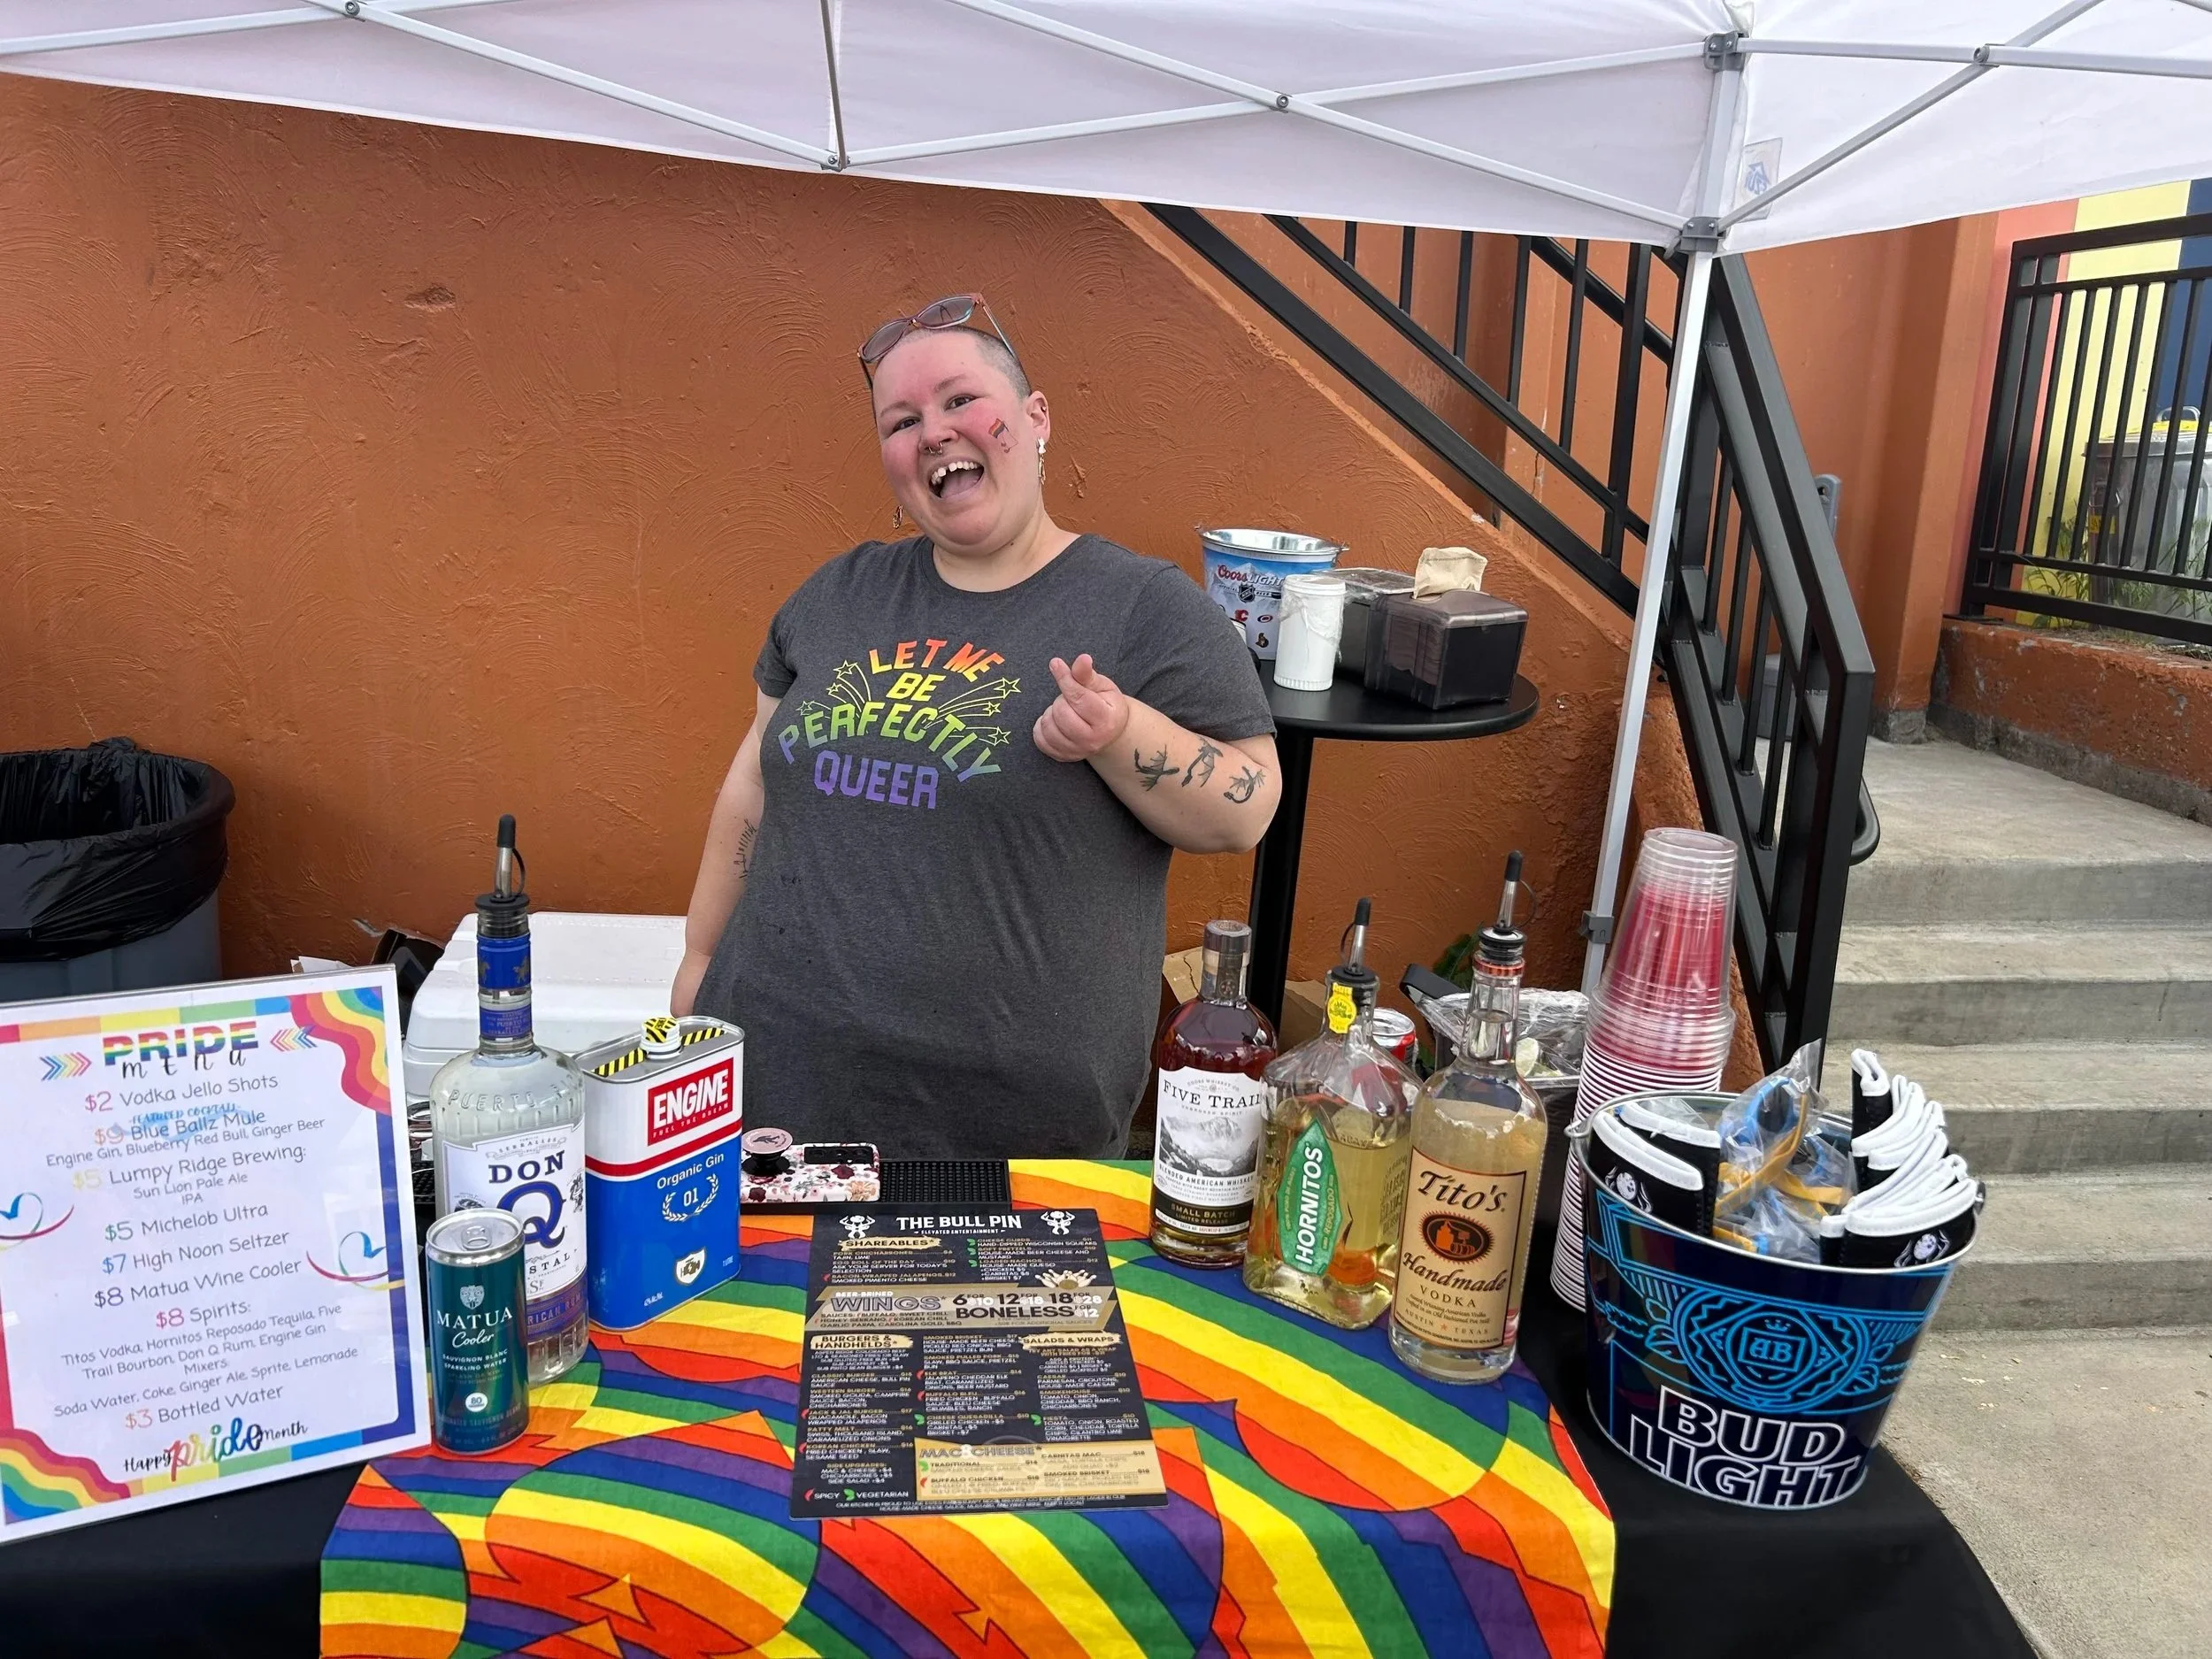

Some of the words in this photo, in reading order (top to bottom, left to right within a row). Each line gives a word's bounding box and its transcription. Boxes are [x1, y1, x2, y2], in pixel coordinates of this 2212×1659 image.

[1217, 565, 1248, 582] Coors
[1248, 573, 1285, 586] LIGHT
[869, 638, 948, 674] LET
[943, 641, 1005, 683] ME
[886, 672, 947, 702] BE
[778, 701, 1002, 783] PERFECTLY
[814, 749, 940, 810] QUEER
[103, 1020, 258, 1066] PRIDE
[85, 1091, 113, 1113] $2
[119, 1087, 176, 1107] Vodka
[181, 1082, 222, 1100] Jello
[227, 1076, 279, 1093] Shots
[654, 1068, 729, 1129] ENGINE
[1164, 1079, 1201, 1105] FIVE
[46, 1151, 93, 1168] Engine
[97, 1147, 122, 1159] Gin,
[126, 1137, 190, 1156] Blueberry
[195, 1133, 219, 1146] Red
[252, 1124, 293, 1139] Ginger
[297, 1119, 326, 1132] Beer
[95, 1125, 124, 1146] $9
[131, 1124, 169, 1141] Blue
[175, 1117, 219, 1134] Ballz
[223, 1110, 266, 1128] Mule
[73, 1169, 103, 1190] $5
[109, 1164, 173, 1185] Lumpy
[179, 1156, 227, 1176] Ridge
[232, 1146, 306, 1166] Brewing:
[488, 1150, 565, 1184] DON
[657, 1164, 703, 1190] Organic
[705, 1153, 725, 1168] Gin
[1159, 1164, 1183, 1180] BLENDED
[1186, 1176, 1224, 1187] AMERICAN
[1227, 1175, 1254, 1186] WHISKEY
[134, 1187, 160, 1200] Sun
[165, 1182, 192, 1194] Lion
[196, 1178, 223, 1190] Pale
[228, 1172, 249, 1185] Ale
[181, 1193, 204, 1206] IPA
[683, 1187, 699, 1207] 01
[1417, 1170, 1509, 1213] Tito's
[104, 1221, 134, 1242] $5
[142, 1211, 218, 1235] Michelob
[224, 1205, 269, 1222] Ultra
[496, 1181, 566, 1248] Q
[895, 1217, 934, 1231] THE
[939, 1215, 985, 1227] BULL
[989, 1215, 1022, 1229] PIN
[1171, 1202, 1201, 1217] SMALL
[1175, 1214, 1199, 1223] LIMITED
[1294, 1146, 1324, 1265] HORNITOS
[1325, 1187, 1334, 1235] REPOSADO
[102, 1254, 127, 1274] $7
[133, 1250, 173, 1271] High
[180, 1242, 223, 1261] Noon
[229, 1232, 290, 1253] Seltzer
[529, 1253, 570, 1274] STAL
[94, 1286, 124, 1309] $8
[131, 1280, 189, 1301] Matua
[194, 1271, 244, 1289] Wine
[250, 1260, 302, 1279] Cooler
[1402, 1252, 1509, 1293] Handmade
[156, 1308, 184, 1329] $8
[190, 1301, 251, 1325] Spirits:
[952, 1294, 968, 1305] 6
[997, 1294, 1020, 1305] 12
[1048, 1293, 1072, 1304] 18
[956, 1306, 1074, 1318] BONELESS
[1420, 1285, 1476, 1308] VODKA
[436, 1307, 512, 1330] MATUA
[528, 1306, 560, 1325] RICAN
[1405, 1309, 1433, 1326] AUSTIN
[61, 1352, 96, 1365] Titos
[99, 1343, 142, 1359] Vodka,
[147, 1332, 202, 1350] Hornitos
[206, 1320, 266, 1340] Reposado
[319, 1305, 342, 1317] Five
[81, 1365, 112, 1379] Trail
[118, 1355, 174, 1373] Bourbon,
[178, 1349, 204, 1362] Don
[208, 1345, 219, 1356] Q
[259, 1330, 302, 1346] Engine
[305, 1324, 326, 1336] Gin
[452, 1329, 495, 1348] Cooler
[442, 1354, 482, 1363] SAUVIGNON
[485, 1348, 508, 1361] BLANC
[483, 1357, 507, 1369] WATER
[54, 1403, 88, 1417] Soda
[91, 1394, 139, 1409] Water,
[180, 1375, 221, 1394] Ginger
[295, 1347, 358, 1369] Lemonade
[125, 1409, 153, 1430] $3
[158, 1398, 219, 1423] Bottled
[225, 1386, 284, 1408] Water
[1658, 1384, 1846, 1468] BUD
[124, 1448, 173, 1472] Happy
[164, 1417, 263, 1482] pride
[260, 1420, 309, 1440] month
[1630, 1413, 1863, 1507] LIGHT
